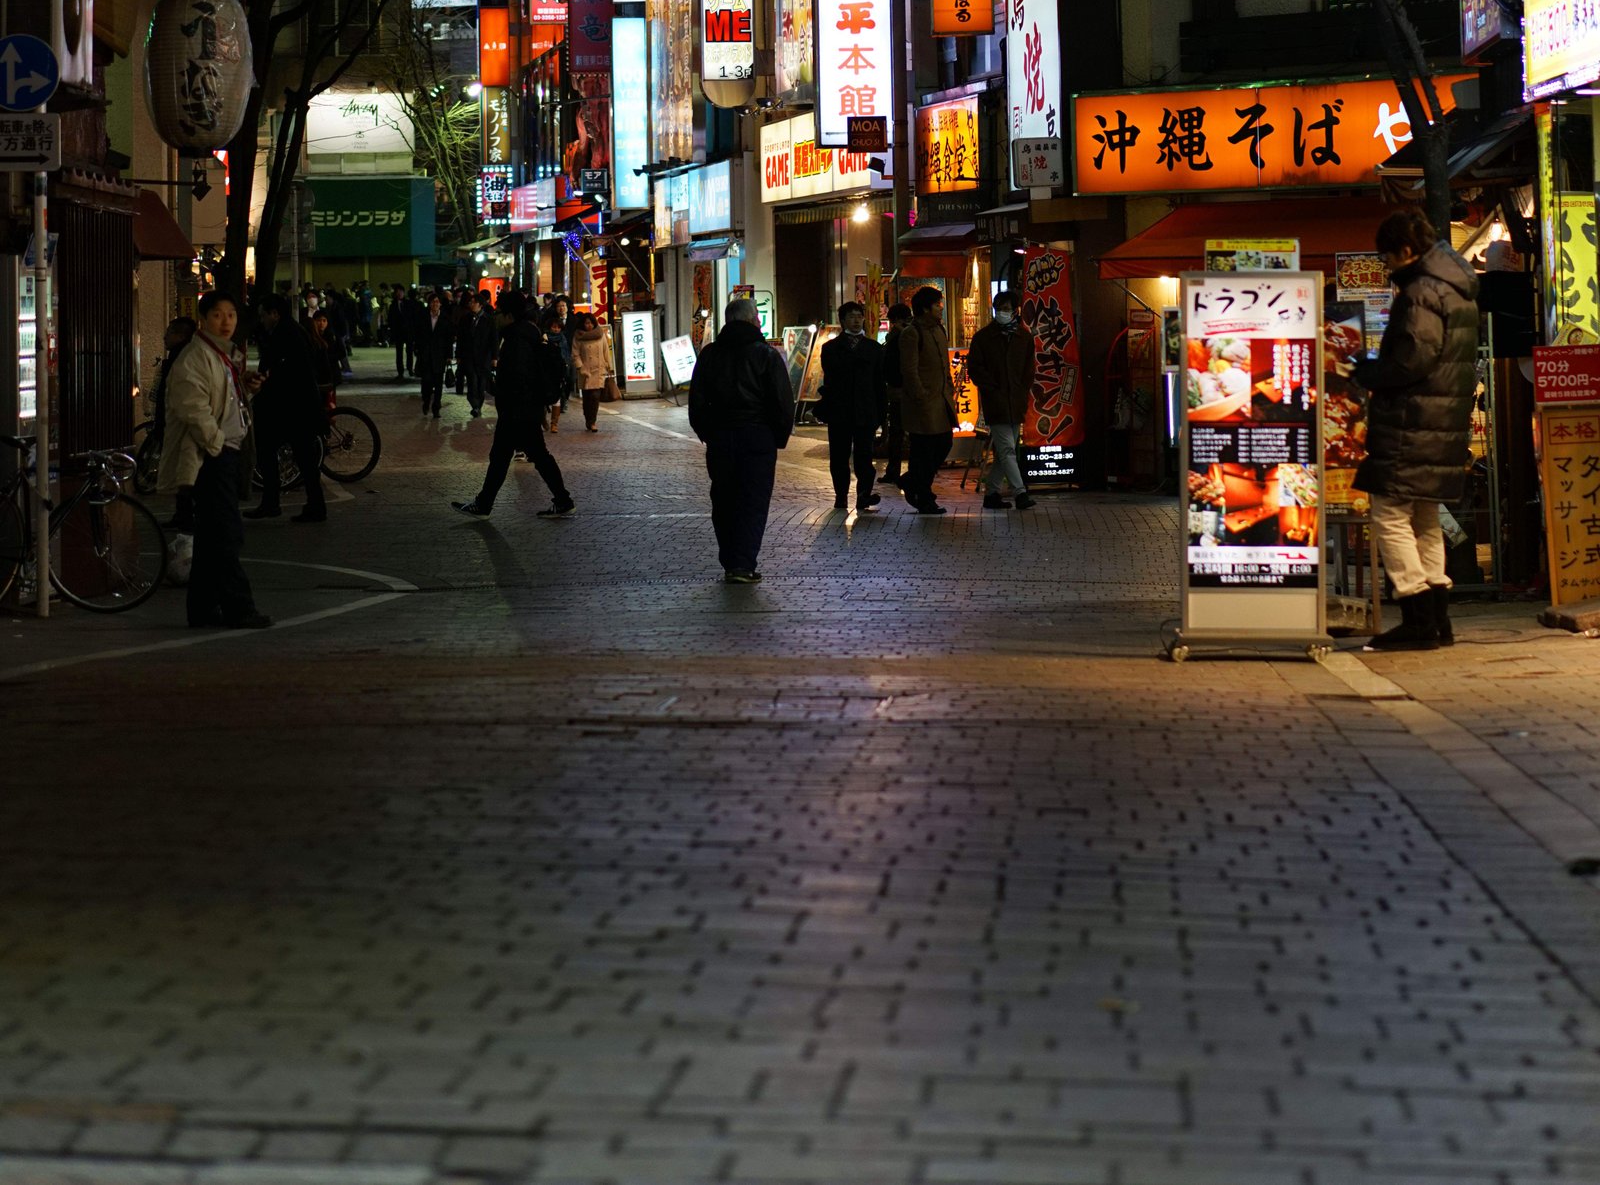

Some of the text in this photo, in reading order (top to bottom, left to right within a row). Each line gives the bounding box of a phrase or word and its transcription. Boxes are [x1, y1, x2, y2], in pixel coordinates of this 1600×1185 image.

[851, 120, 880, 132] MOA
[0, 136, 53, 151] 方通行
[1093, 98, 1345, 174] 沖縄そば
[765, 152, 790, 189] GAME
[310, 210, 406, 227] ミシンプラザ
[1536, 360, 1570, 373] 70分
[1551, 422, 1597, 440] 本格
[1553, 456, 1579, 569] マッサージ
